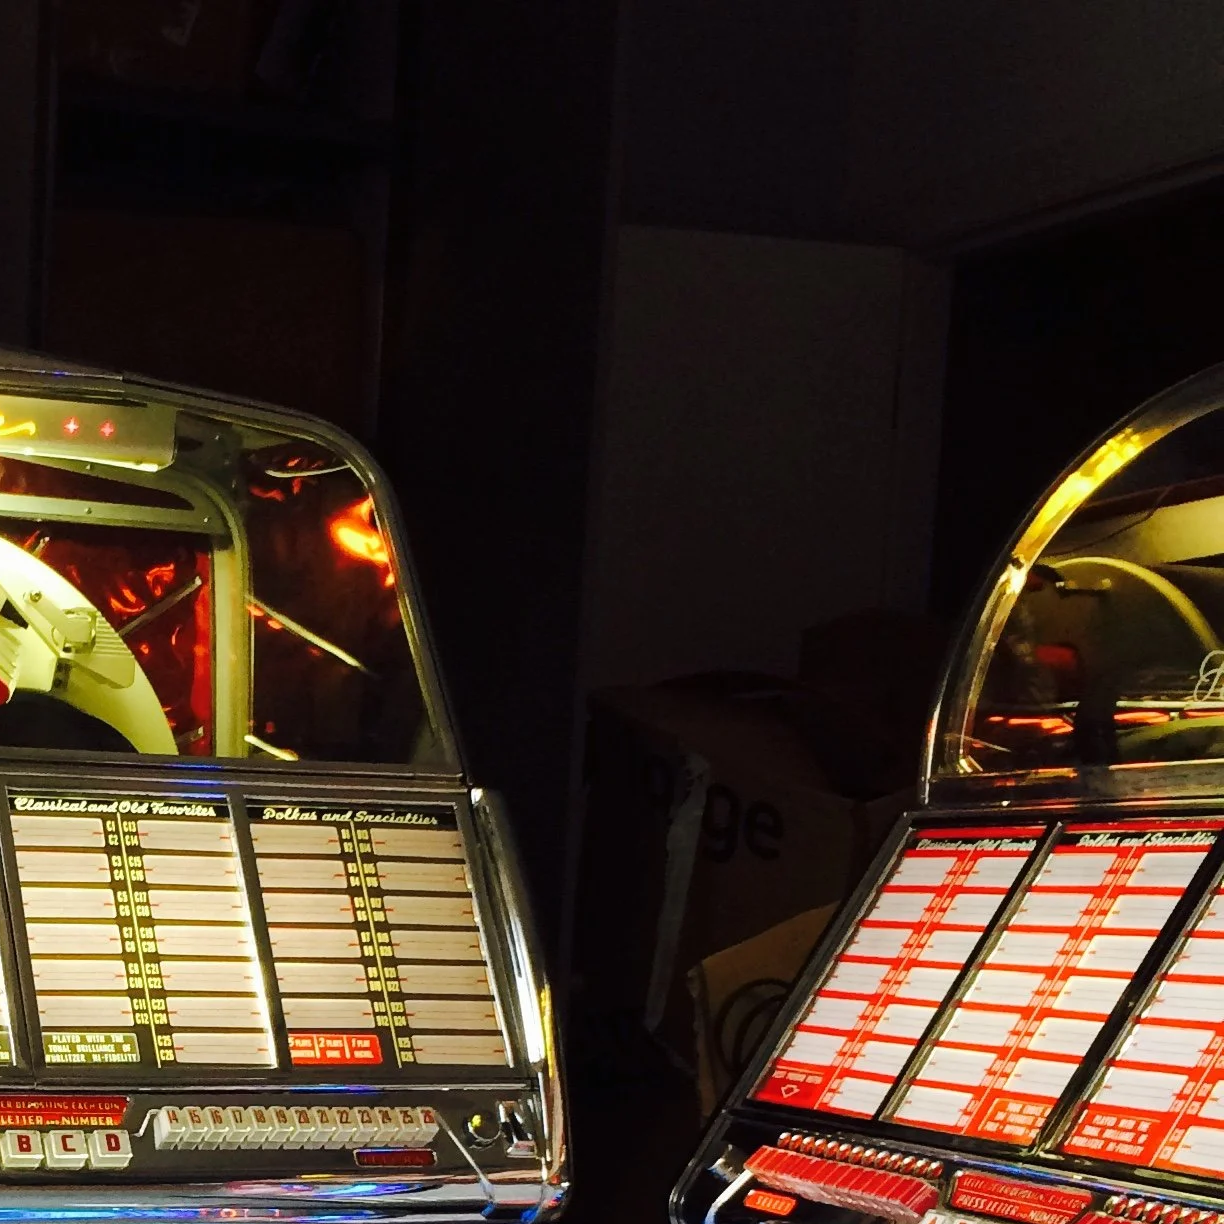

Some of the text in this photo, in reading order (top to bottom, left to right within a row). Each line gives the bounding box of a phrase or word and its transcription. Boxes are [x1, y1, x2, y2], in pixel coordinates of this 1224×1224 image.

[14, 797, 217, 817] Classical and Old Favorites
[262, 807, 318, 821] Polkas
[322, 810, 352, 822] and
[0, 1114, 44, 1125] LETTER
[61, 1116, 114, 1127] NUMBER
[166, 1110, 178, 1124] 14
[188, 1110, 201, 1124] 15
[210, 1110, 223, 1124] 16
[232, 1110, 243, 1124] 17
[16, 1134, 32, 1153] B
[61, 1134, 77, 1152] C
[105, 1133, 121, 1152] D
[956, 1194, 988, 1210] PRESS
[986, 1200, 1019, 1216] LETTER
